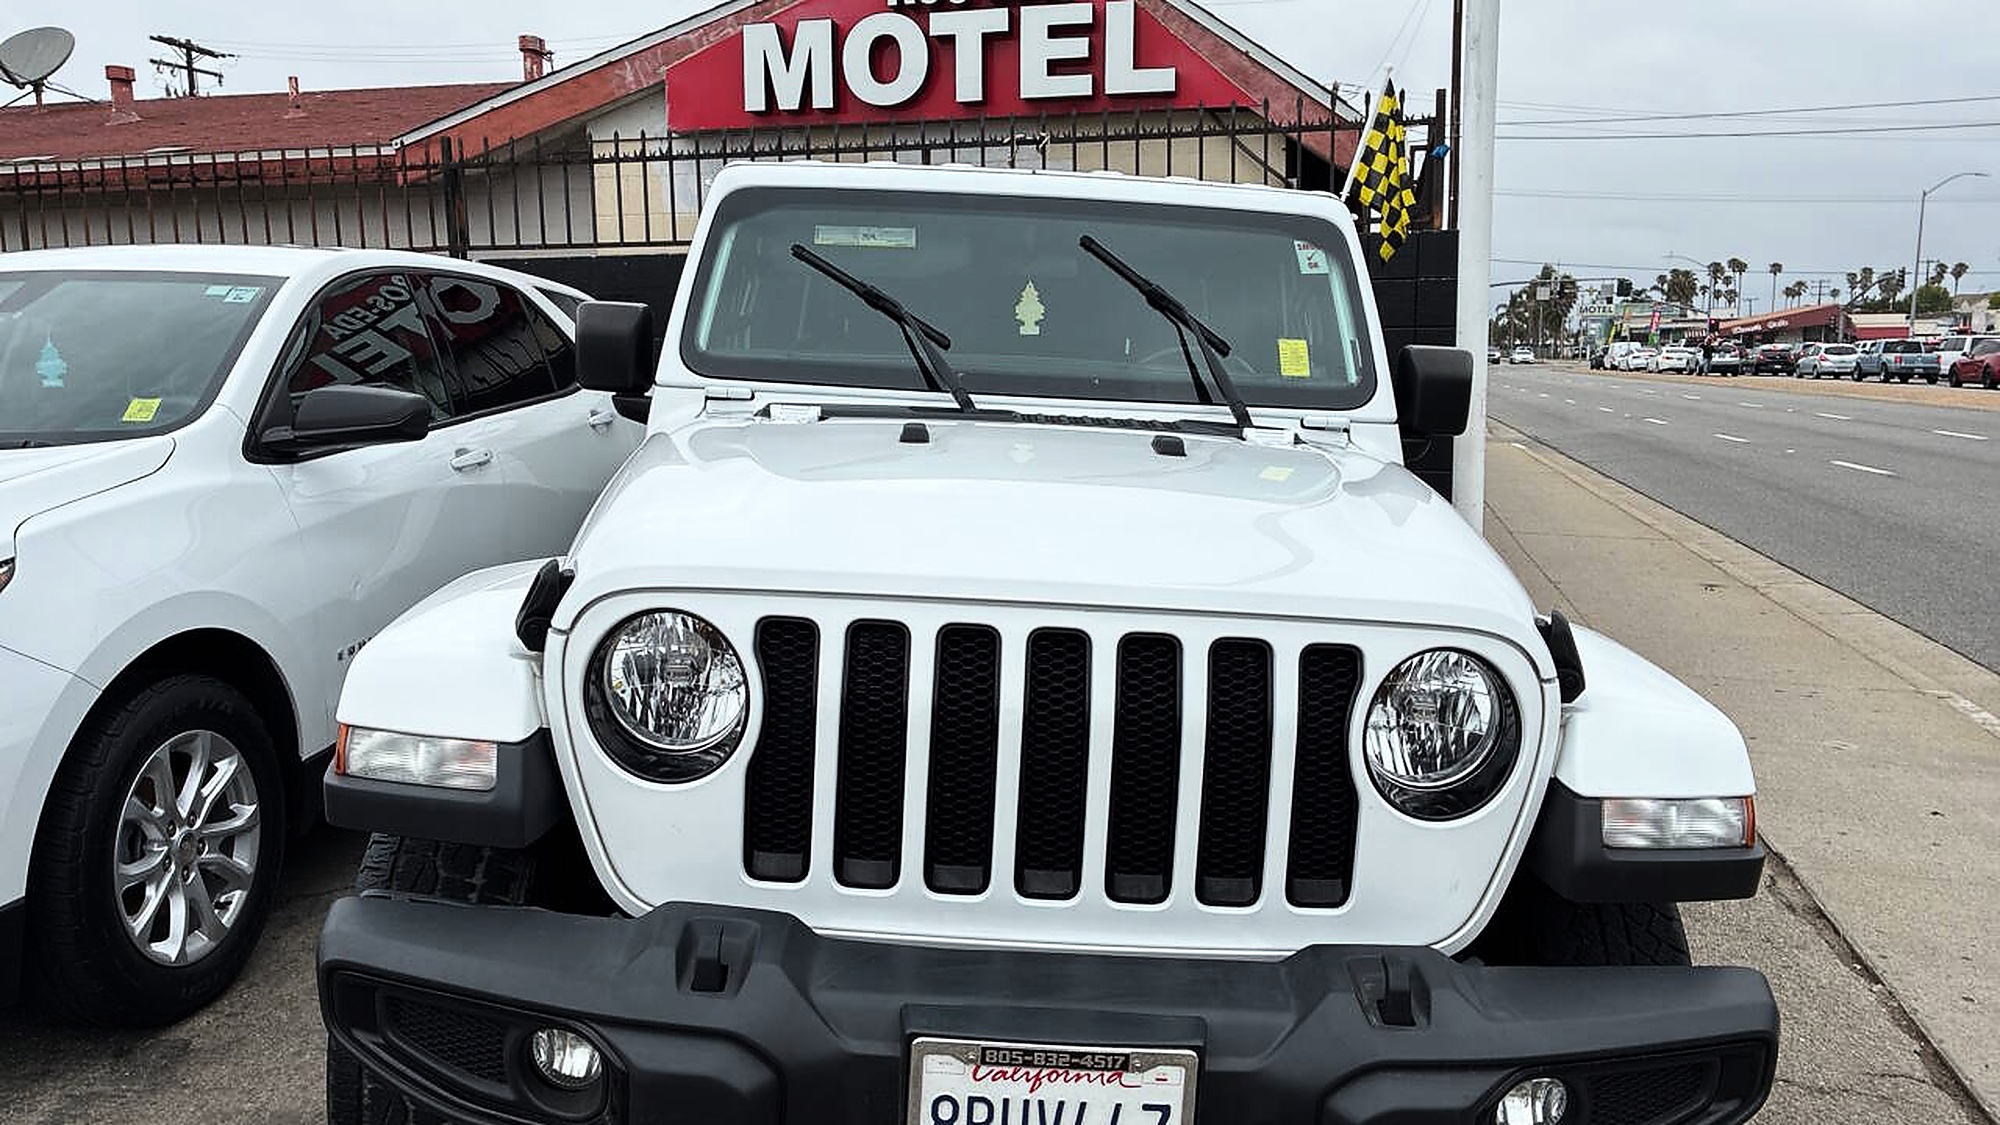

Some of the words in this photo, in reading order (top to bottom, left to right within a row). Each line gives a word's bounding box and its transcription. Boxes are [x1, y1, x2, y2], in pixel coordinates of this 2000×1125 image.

[743, 1, 1176, 112] MOTEL
[1579, 305, 1614, 314] MOTEL
[985, 1049, 1127, 1068] 805-832-4517
[972, 1064, 1142, 1094] California
